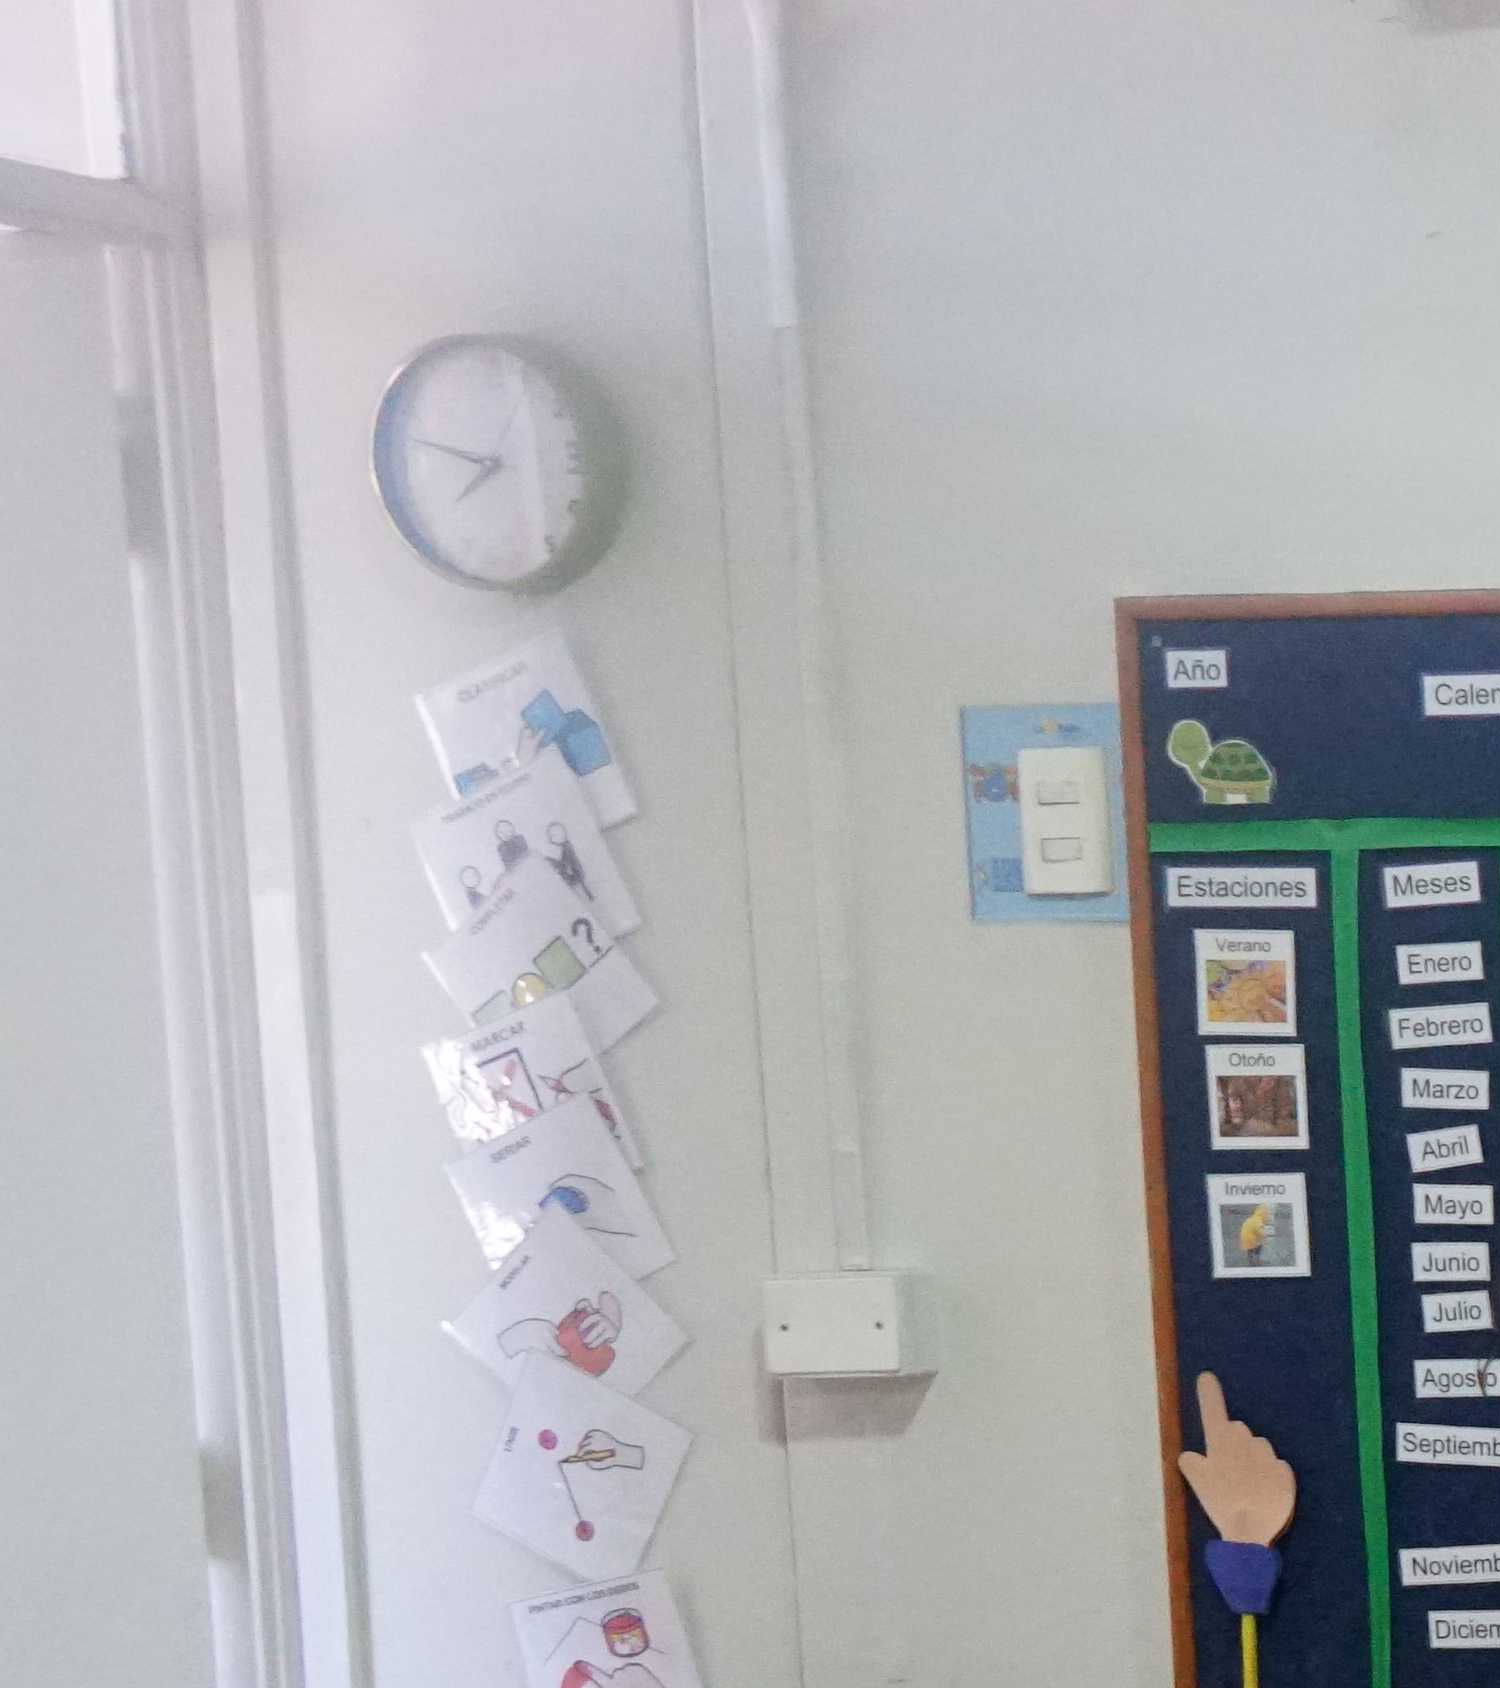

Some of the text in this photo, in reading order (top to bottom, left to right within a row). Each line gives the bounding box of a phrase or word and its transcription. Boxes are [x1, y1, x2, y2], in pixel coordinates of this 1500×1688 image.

[1173, 656, 1221, 682] Año
[1176, 875, 1308, 901] Estaciones
[1392, 872, 1472, 898] Meses
[1216, 938, 1271, 954] Verano
[1407, 951, 1473, 976] Enero
[1397, 1013, 1484, 1040] Febrero
[1227, 1051, 1276, 1069] Otoño
[1411, 1077, 1481, 1103] Marzo
[1422, 1134, 1471, 1163] Abril
[1223, 1181, 1287, 1196] Invierno
[1423, 1194, 1484, 1220] Mayo
[1421, 1251, 1481, 1275] Junio
[1431, 1301, 1483, 1324] Julio
